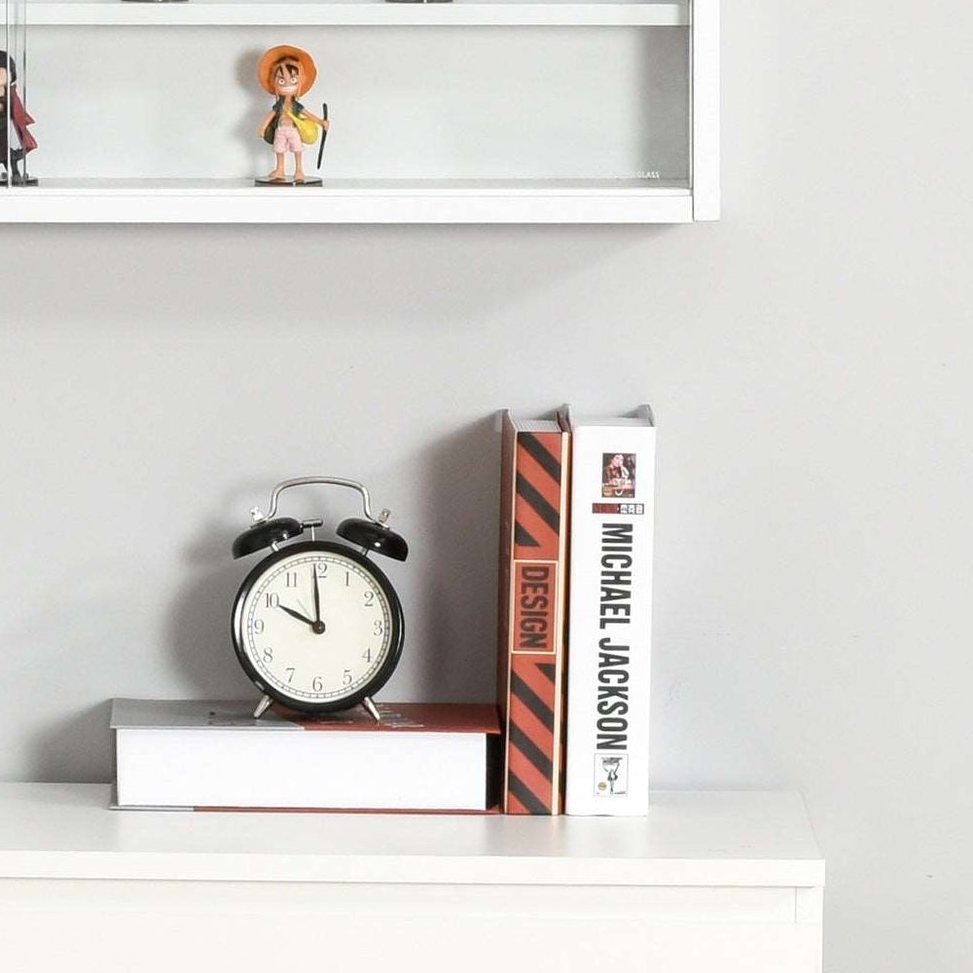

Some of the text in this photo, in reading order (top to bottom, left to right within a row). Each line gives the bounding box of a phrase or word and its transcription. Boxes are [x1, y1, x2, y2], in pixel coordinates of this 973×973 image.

[312, 563, 328, 578] 2
[599, 523, 633, 630] MICHAEL
[286, 571, 298, 588] 11
[344, 572, 350, 587] 1
[265, 592, 280, 608] 10
[363, 592, 374, 607] 2
[519, 566, 549, 650] DESIGN
[254, 619, 265, 635] 9
[373, 620, 384, 636] 3
[263, 647, 273, 664] 8
[362, 647, 373, 663] 4
[285, 667, 296, 683] 7
[343, 669, 353, 685] 5
[312, 676, 323, 692] 6
[596, 637, 630, 750] JACKSON
